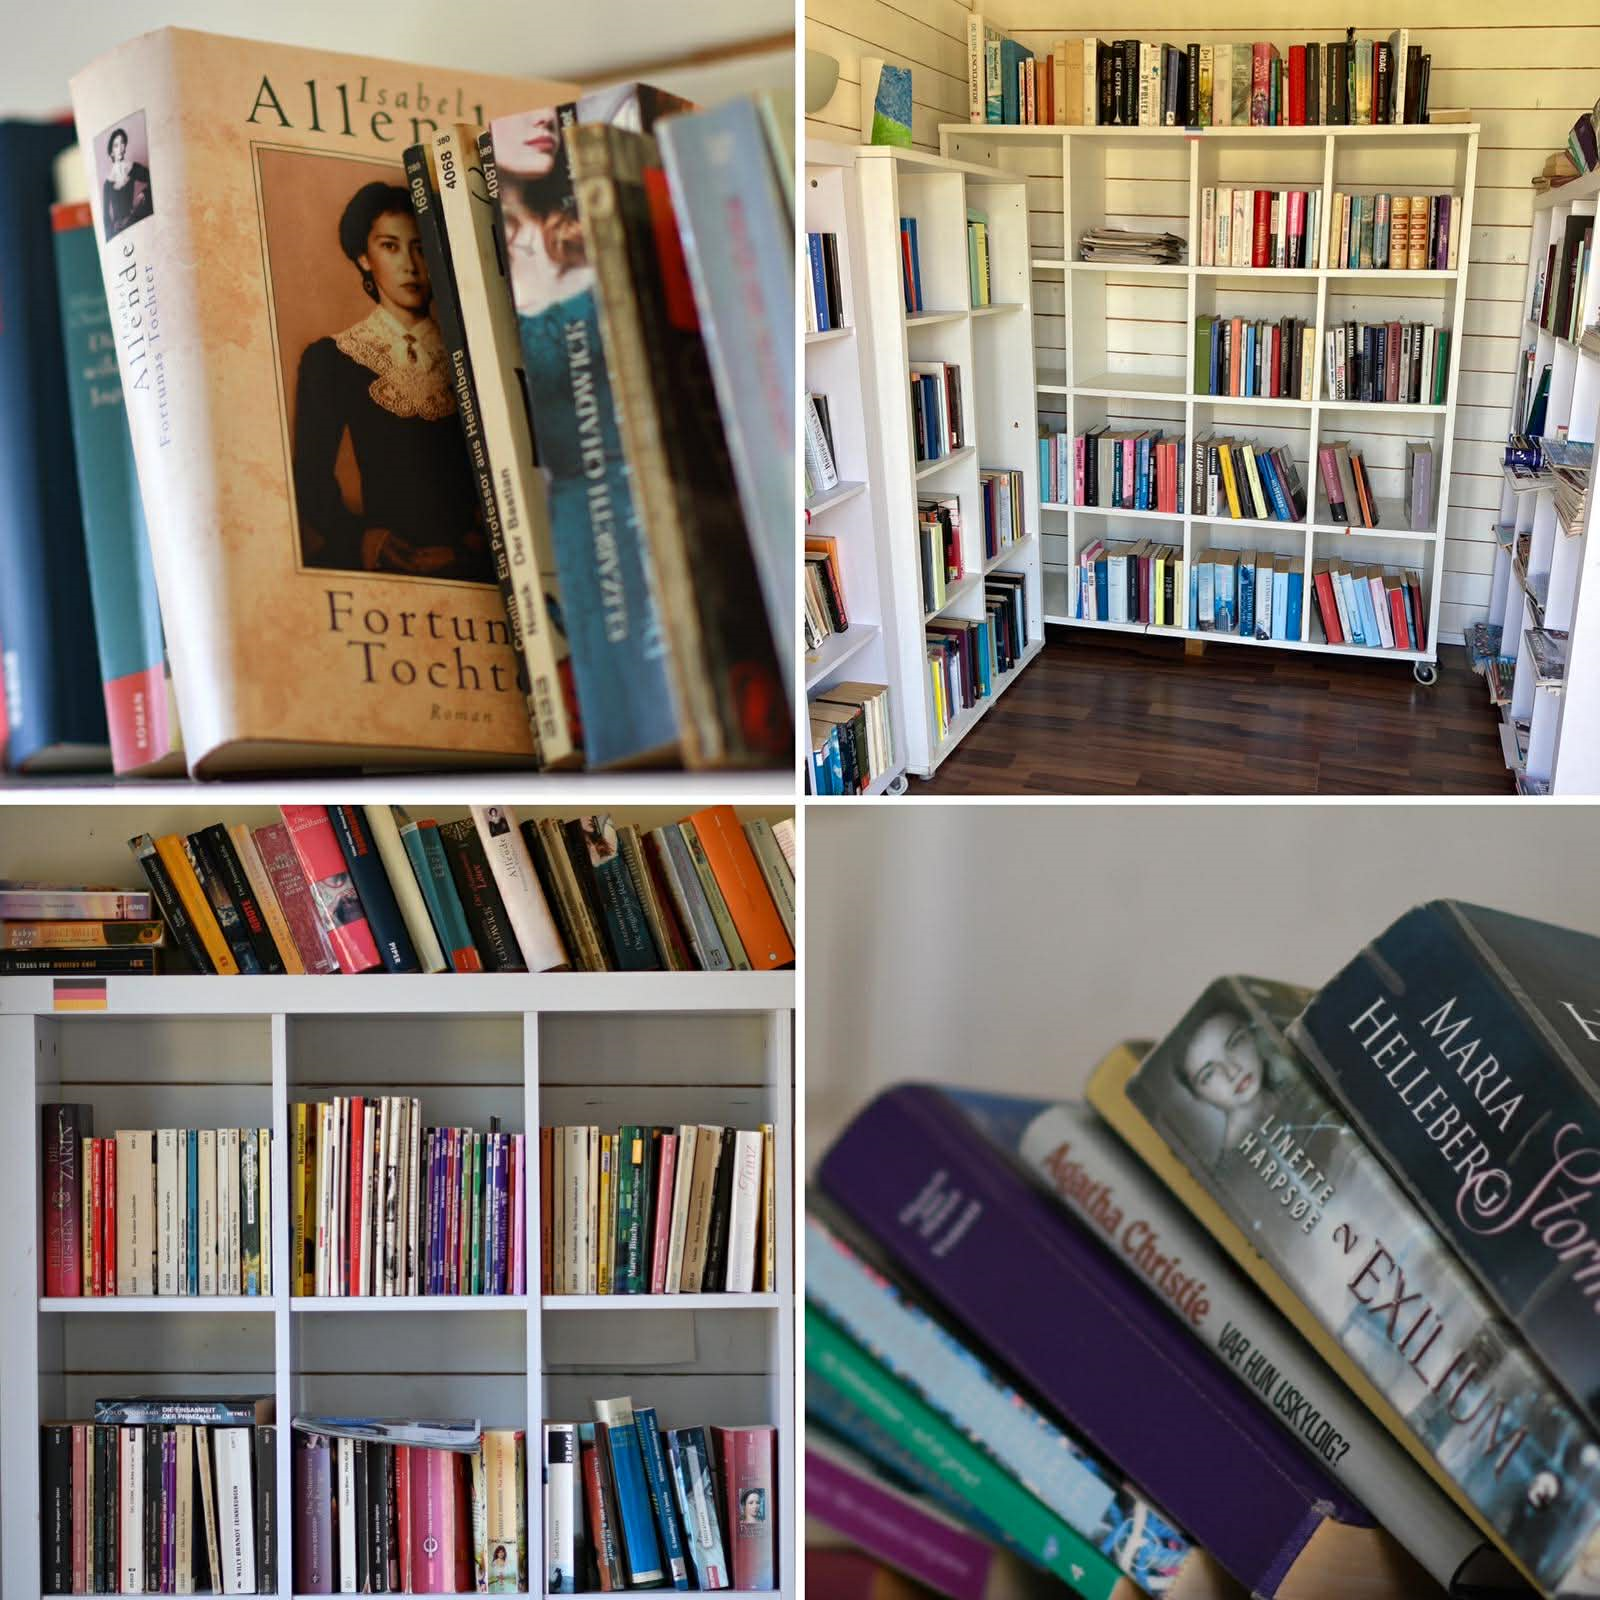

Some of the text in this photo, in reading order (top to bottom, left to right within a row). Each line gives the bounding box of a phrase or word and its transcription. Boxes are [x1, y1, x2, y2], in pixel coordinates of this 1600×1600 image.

[356, 74, 464, 118] Isabel
[436, 135, 451, 147] 380
[411, 177, 429, 215] 1680
[440, 150, 457, 190] 4068
[120, 241, 151, 392] Allende
[143, 265, 159, 342] Tochter
[450, 350, 478, 437] Heidelberg
[470, 441, 486, 467] aus
[566, 321, 626, 642] ELIZABETH CHADWICK
[479, 473, 503, 549] Professor
[499, 469, 520, 530] Bastian
[493, 552, 510, 579] Ein
[512, 537, 525, 565] Der
[327, 590, 511, 645] Fortun
[347, 640, 516, 693] Tocht
[430, 703, 494, 723] Roman
[388, 941, 401, 964] PIPER
[1420, 996, 1525, 1132] MARIA
[1349, 996, 1512, 1209] HELLEBERG
[1238, 1132, 1318, 1237] HARPSØE
[1259, 1114, 1336, 1205] LINETTE
[628, 1222, 638, 1249] Binchy
[1042, 1140, 1128, 1245] Agatha
[1118, 1217, 1213, 1328] Christie
[628, 1251, 637, 1277] Maeve
[1346, 1237, 1531, 1479] EXILIUM
[1212, 1321, 1353, 1467] VAR HUN USKYLDIG?
[564, 1434, 573, 1463] PIPER
